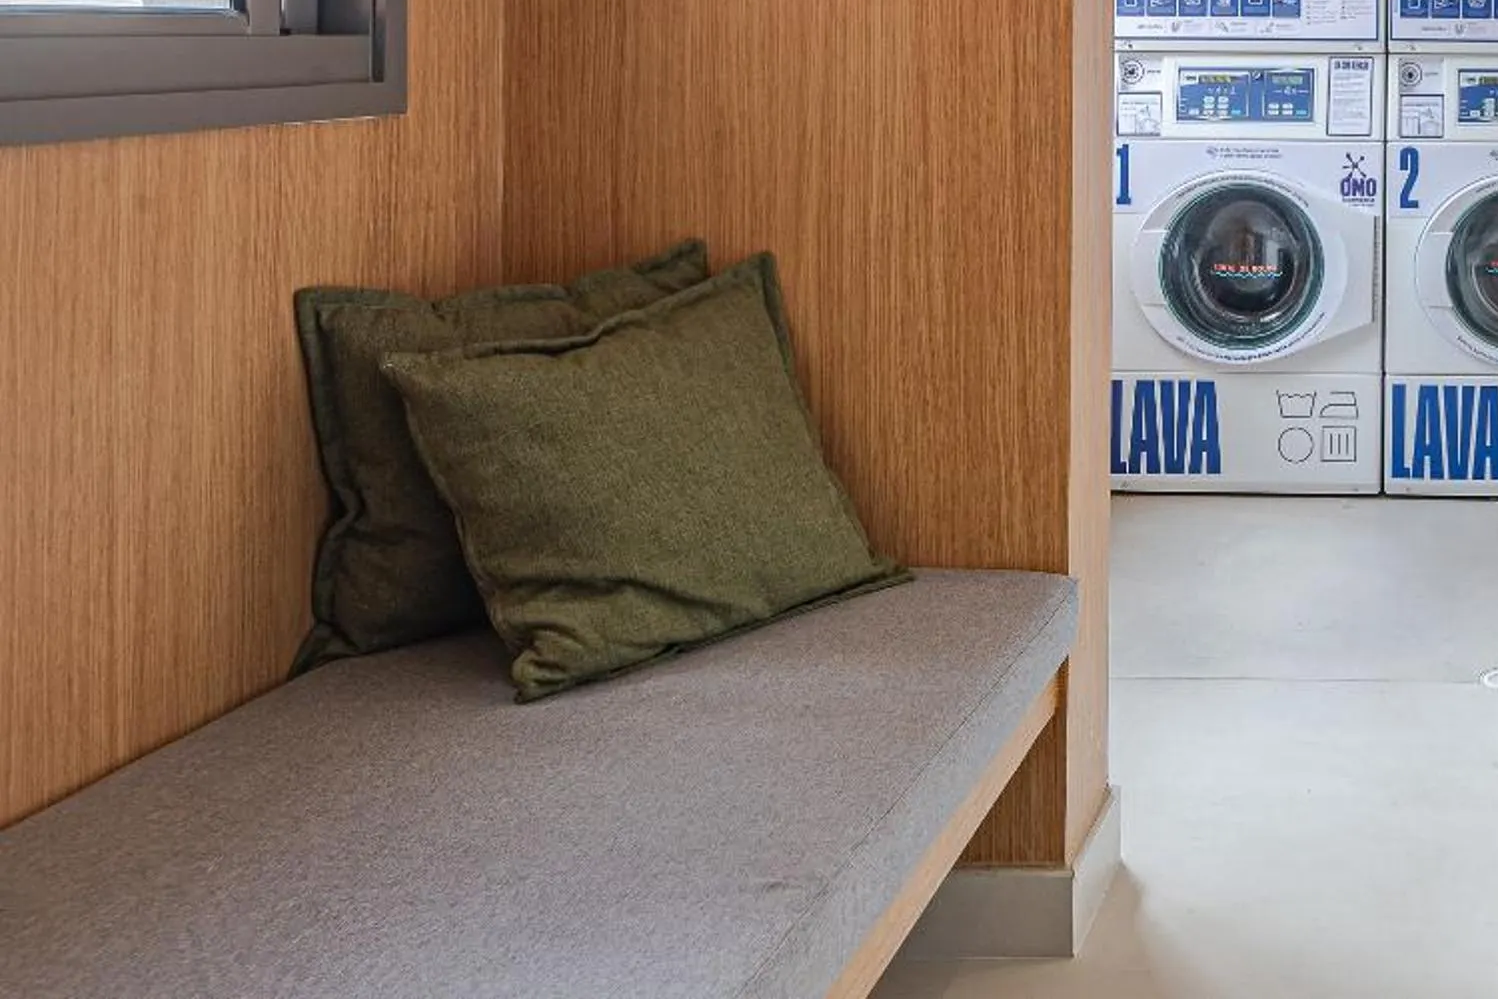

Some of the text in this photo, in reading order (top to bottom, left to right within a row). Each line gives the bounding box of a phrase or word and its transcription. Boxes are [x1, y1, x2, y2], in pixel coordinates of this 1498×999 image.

[1116, 143, 1131, 205] 1
[1340, 177, 1377, 197] OMO
[1399, 146, 1420, 209] 2
[1110, 379, 1222, 475] LAVA
